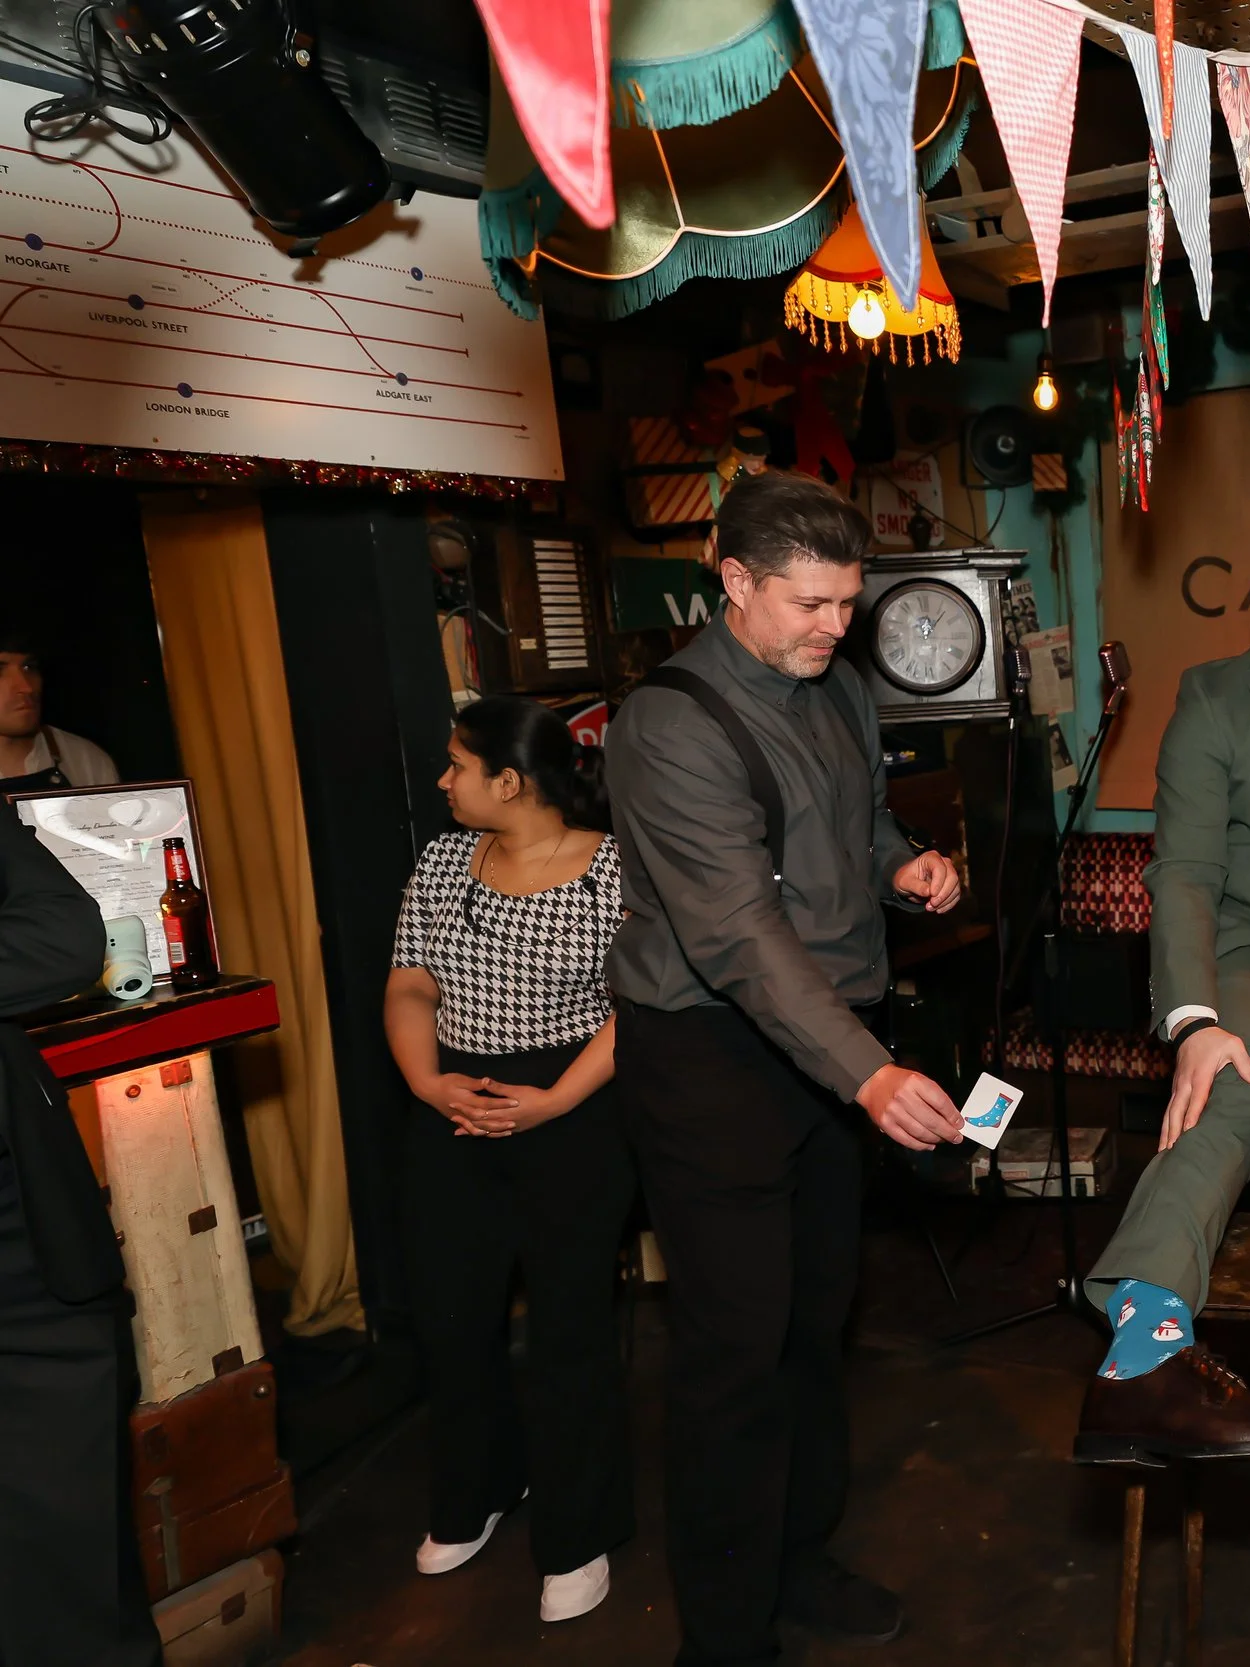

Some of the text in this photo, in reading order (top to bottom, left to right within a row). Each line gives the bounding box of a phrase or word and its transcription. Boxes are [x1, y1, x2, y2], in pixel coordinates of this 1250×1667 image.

[5, 254, 71, 274] MOORGATE
[88, 311, 189, 334] LIVERPOOL STREET
[375, 388, 433, 404] ALDGATE EAST
[145, 402, 230, 419] LONDON BRIDGE
[898, 489, 918, 511] NO
[877, 514, 941, 537] SMOG
